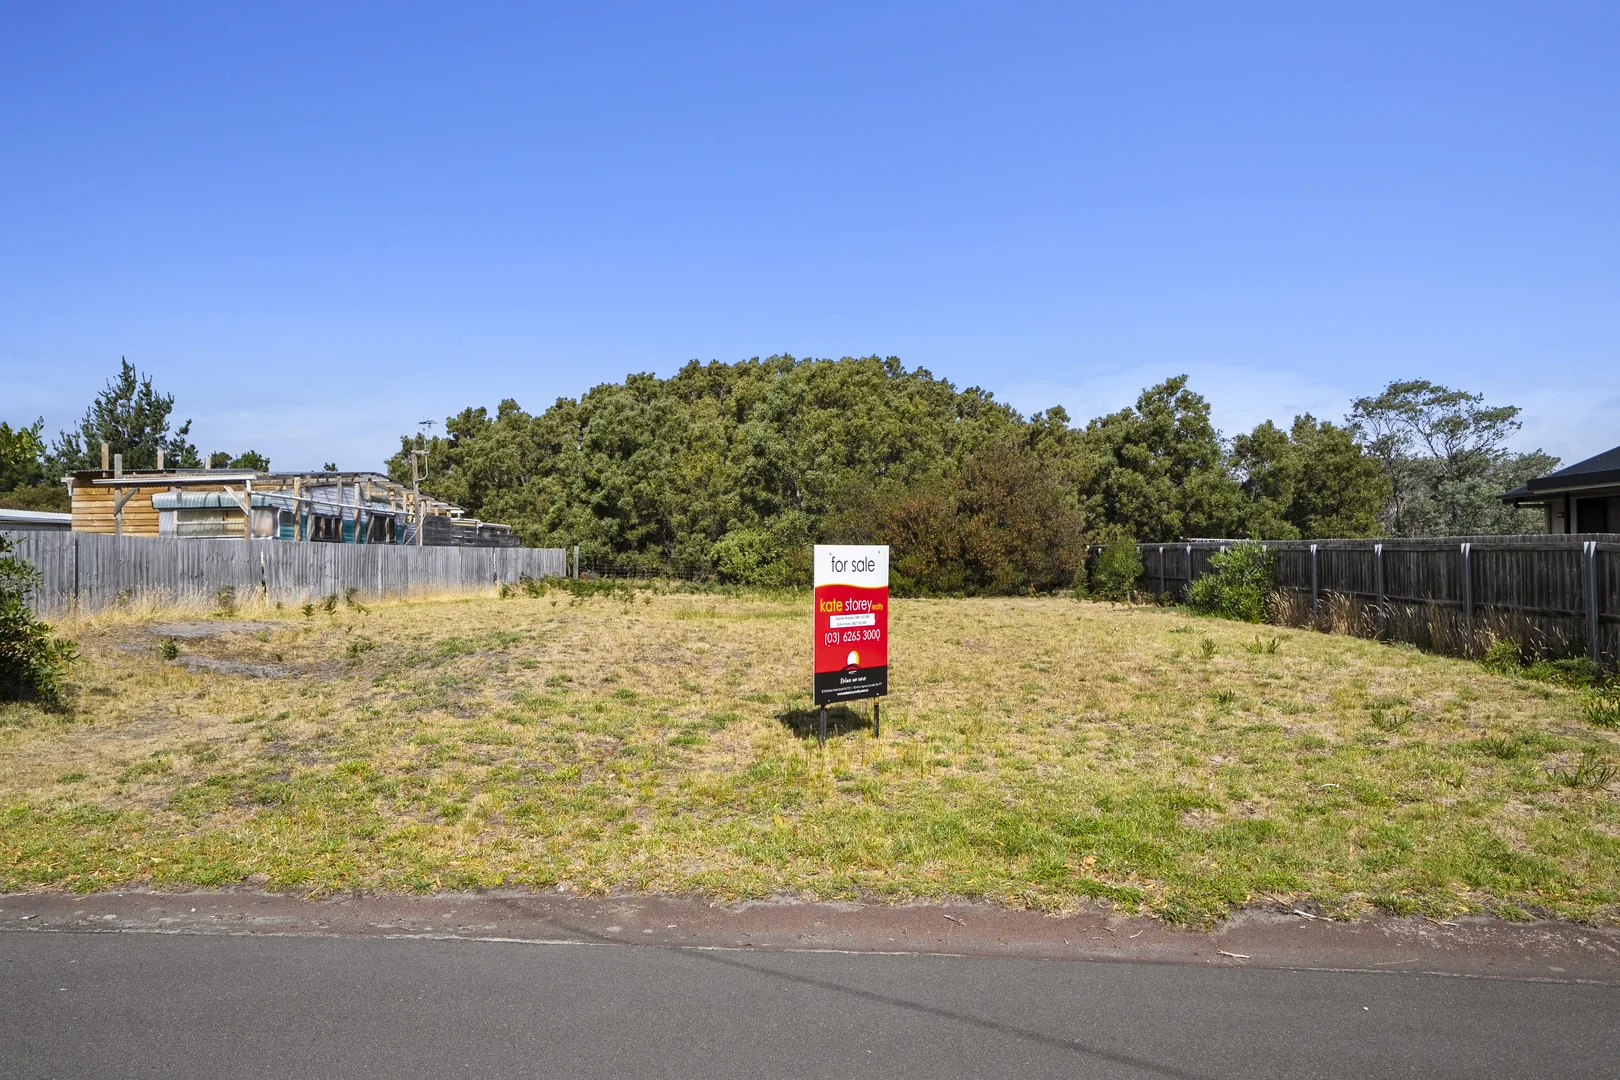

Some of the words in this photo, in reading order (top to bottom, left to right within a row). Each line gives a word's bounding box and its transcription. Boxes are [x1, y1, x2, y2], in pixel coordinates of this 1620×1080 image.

[831, 556, 848, 572] for
[852, 556, 876, 572] sale
[820, 598, 842, 612] kate
[845, 598, 872, 613] storey
[824, 632, 840, 646] (03)
[843, 631, 860, 642] 6265
[862, 629, 880, 640] 3000
